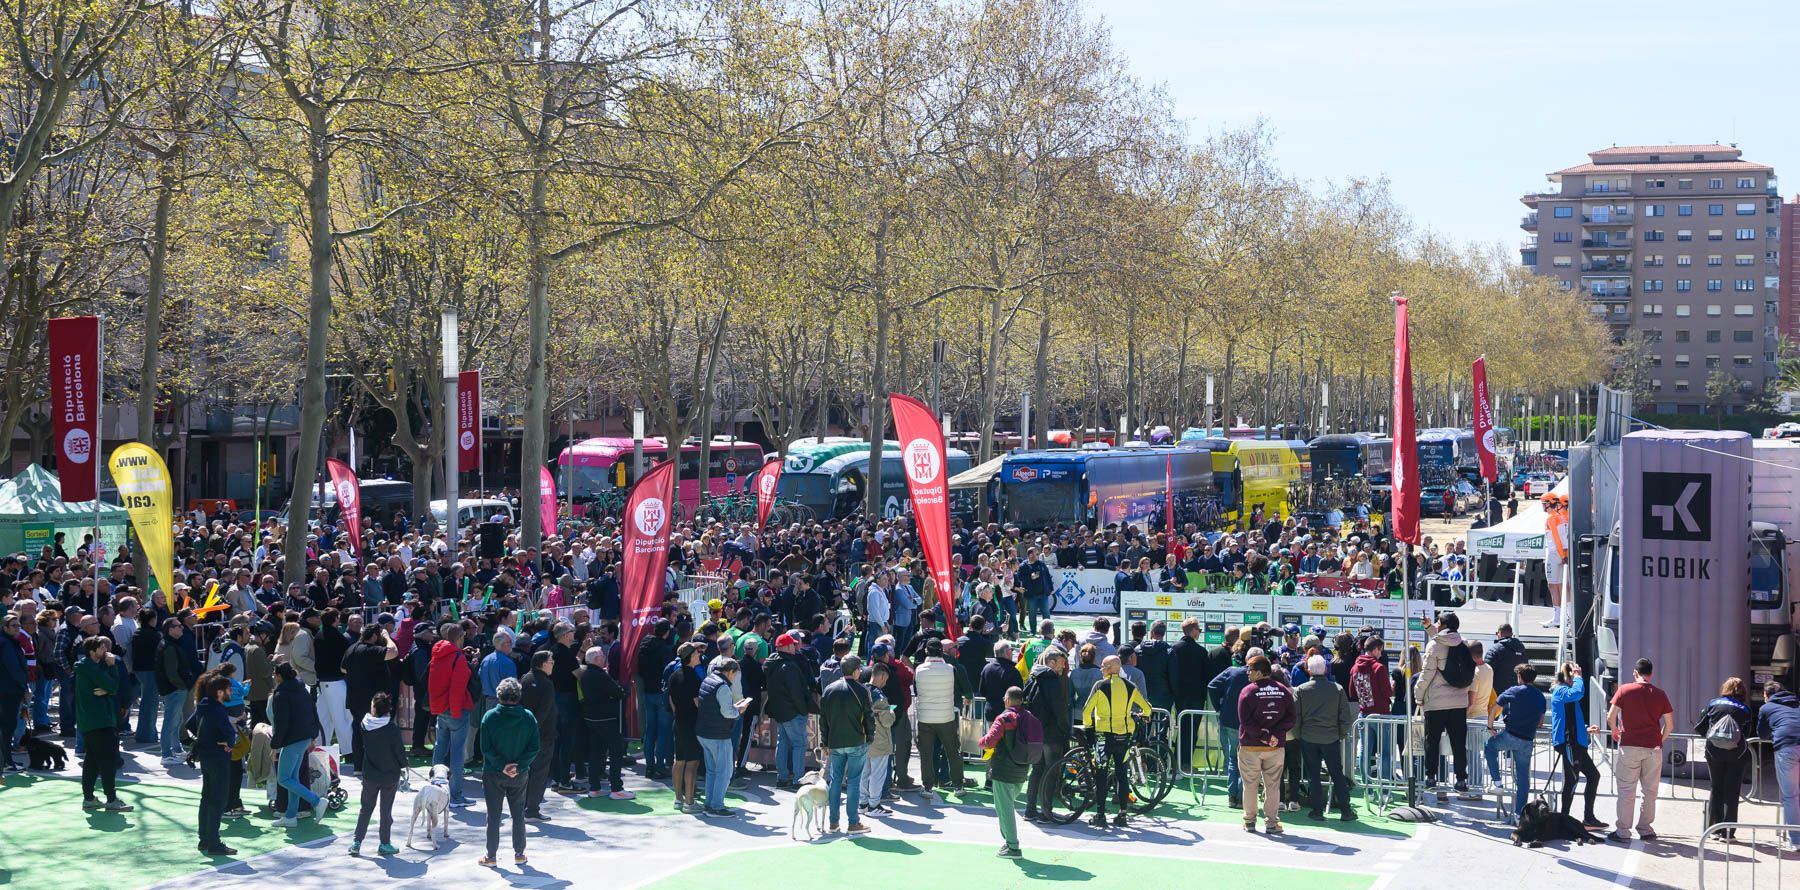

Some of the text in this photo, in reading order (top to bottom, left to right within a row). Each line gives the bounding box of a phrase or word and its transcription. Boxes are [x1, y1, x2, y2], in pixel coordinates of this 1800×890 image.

[63, 354, 75, 422] Diputació
[74, 354, 86, 421] Barcelona
[1641, 555, 1711, 580] GOBIK
[1088, 597, 1099, 605] de
[1187, 599, 1206, 607] Volta
[1344, 604, 1364, 612] Volta
